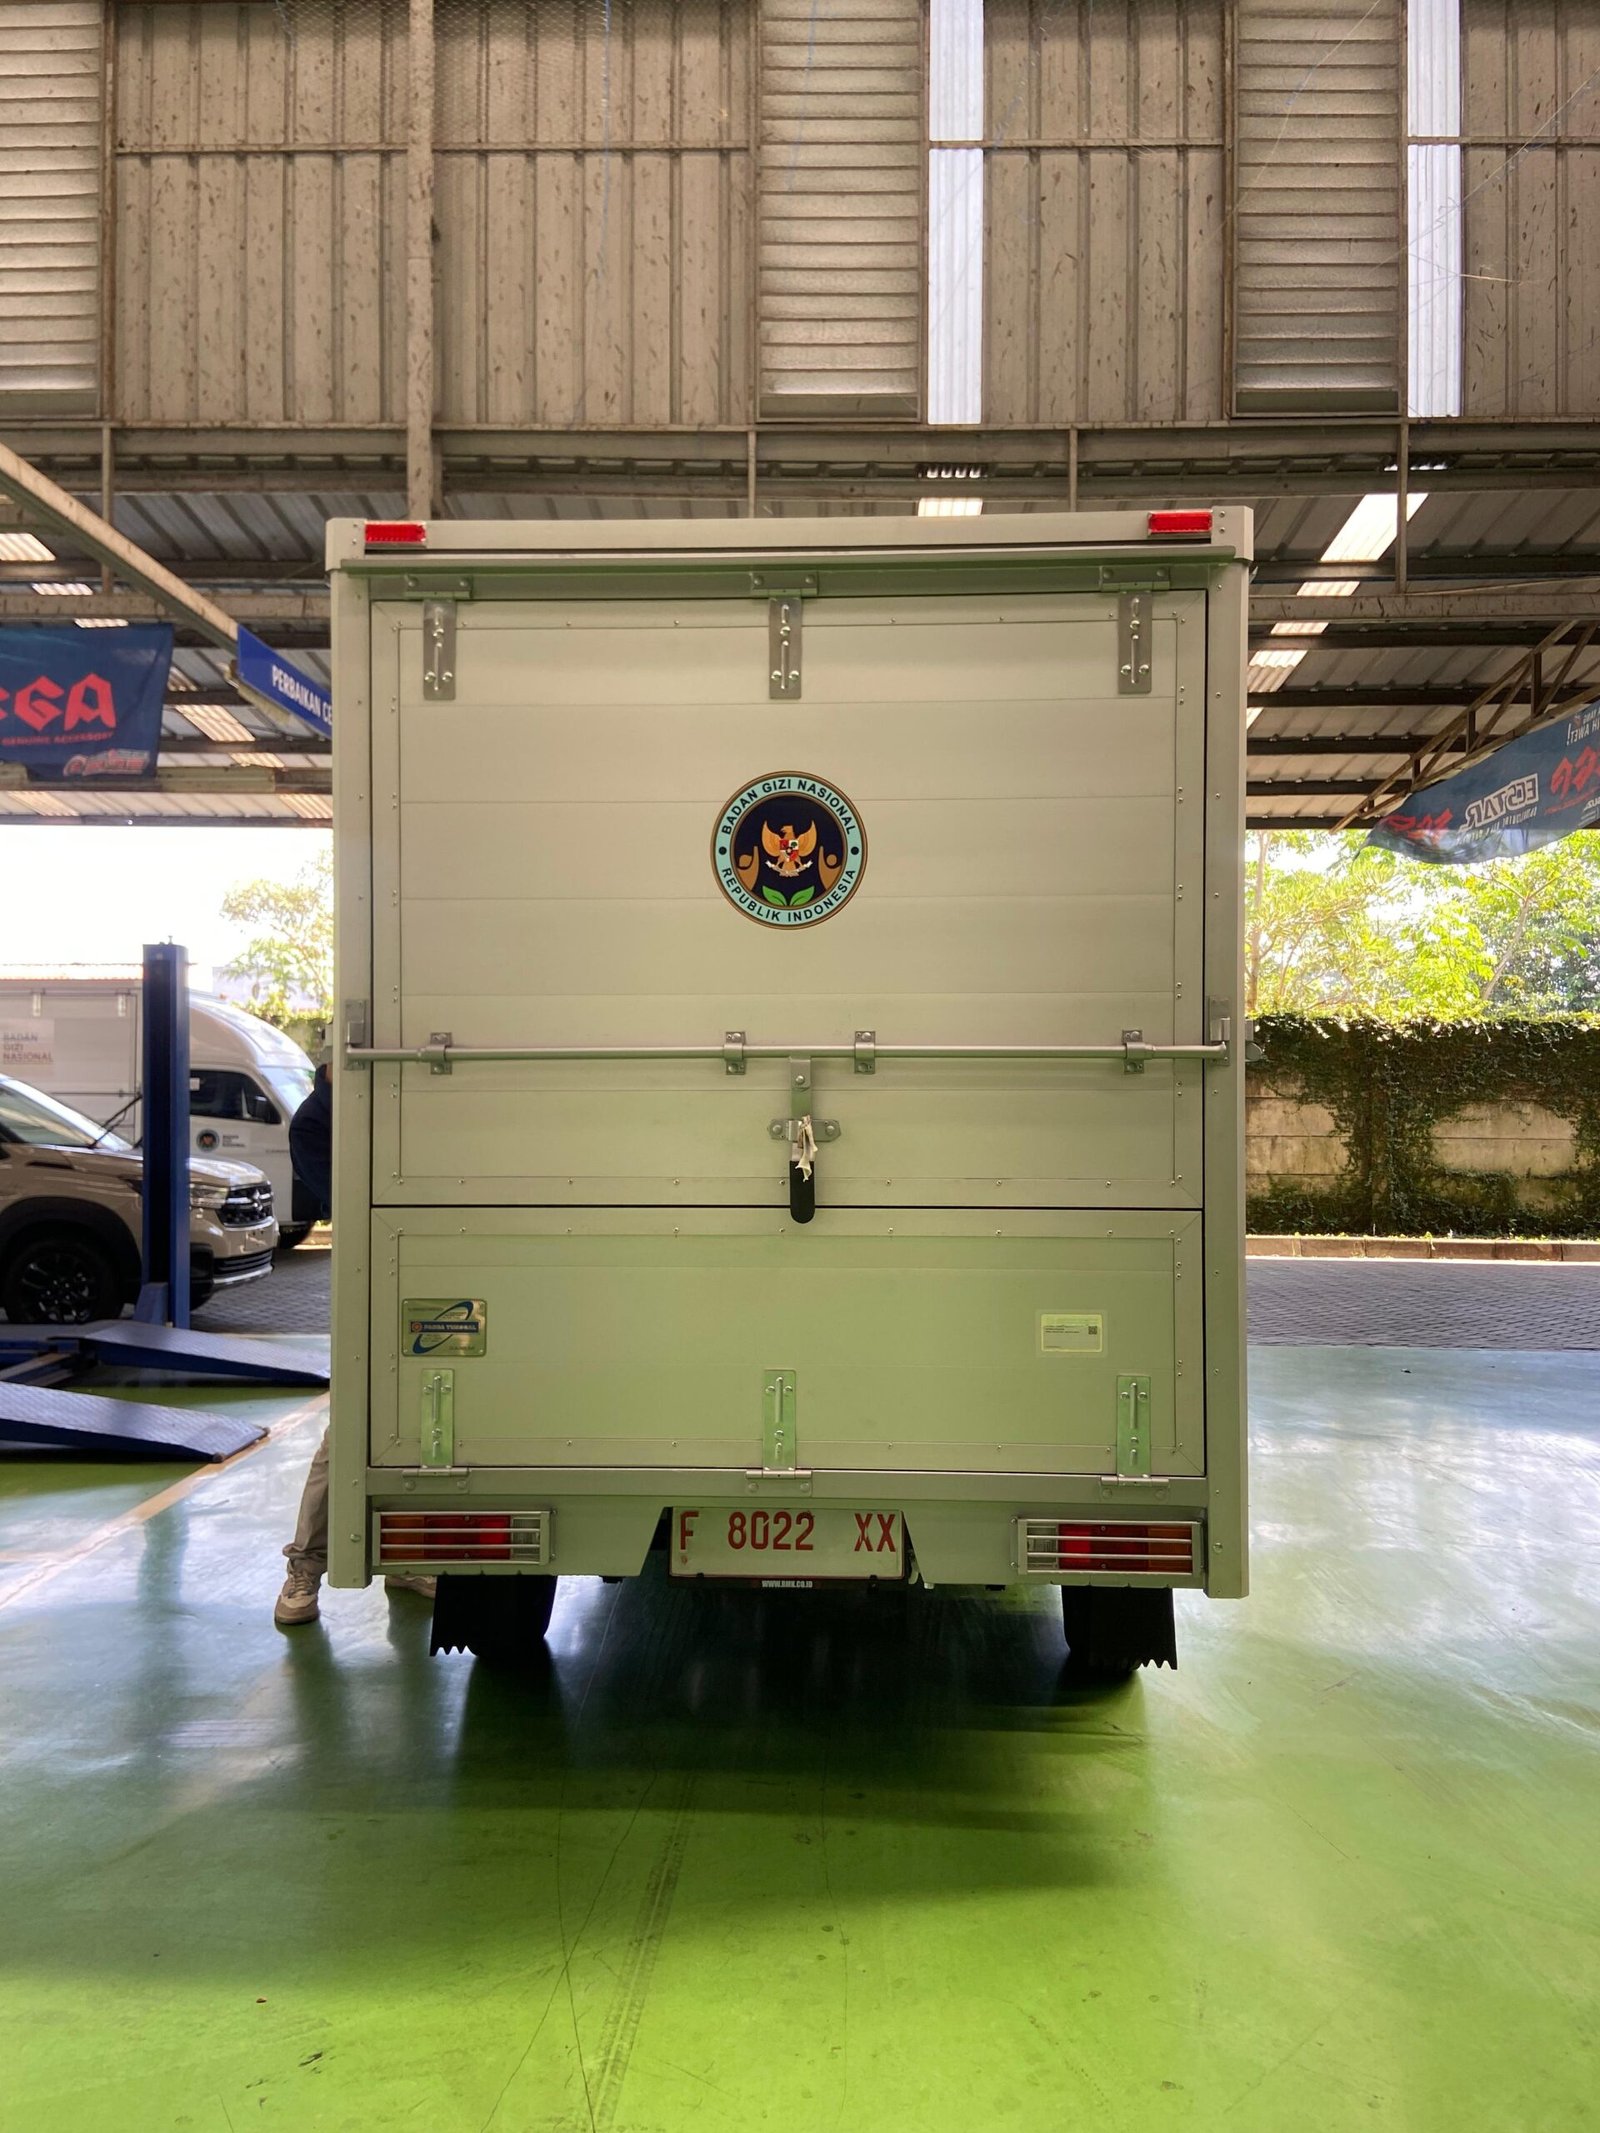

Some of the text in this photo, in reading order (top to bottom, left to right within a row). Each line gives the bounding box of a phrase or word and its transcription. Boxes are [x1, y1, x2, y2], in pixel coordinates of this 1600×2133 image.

[0, 673, 117, 731] GA
[271, 664, 321, 718] PERBAIKAN
[721, 779, 856, 835] BADAN GIZI NASIONAL
[722, 867, 856, 922] REPUBLIK INDONESIA
[680, 1510, 896, 1552] F 8022 XX
